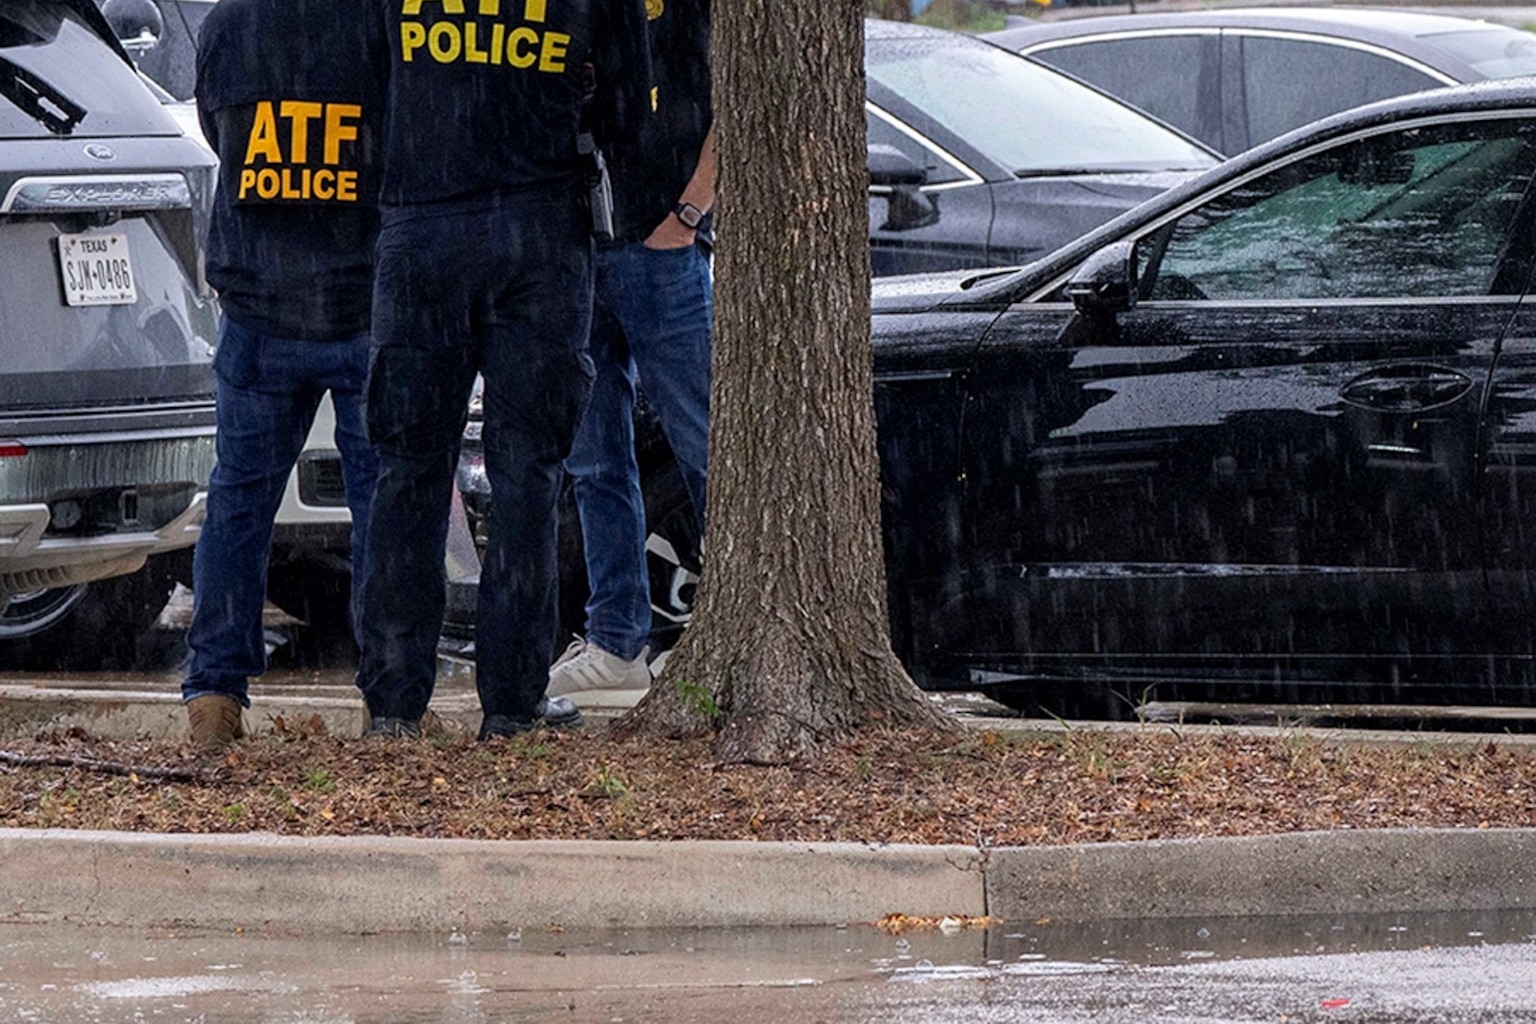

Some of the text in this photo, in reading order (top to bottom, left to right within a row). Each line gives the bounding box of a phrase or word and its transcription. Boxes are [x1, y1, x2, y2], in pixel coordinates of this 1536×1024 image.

[401, 21, 571, 73] POLICE
[244, 100, 362, 165] ATF
[45, 186, 170, 204] EXPLORER
[238, 167, 358, 202] POLICE
[80, 239, 108, 254] TEXAS
